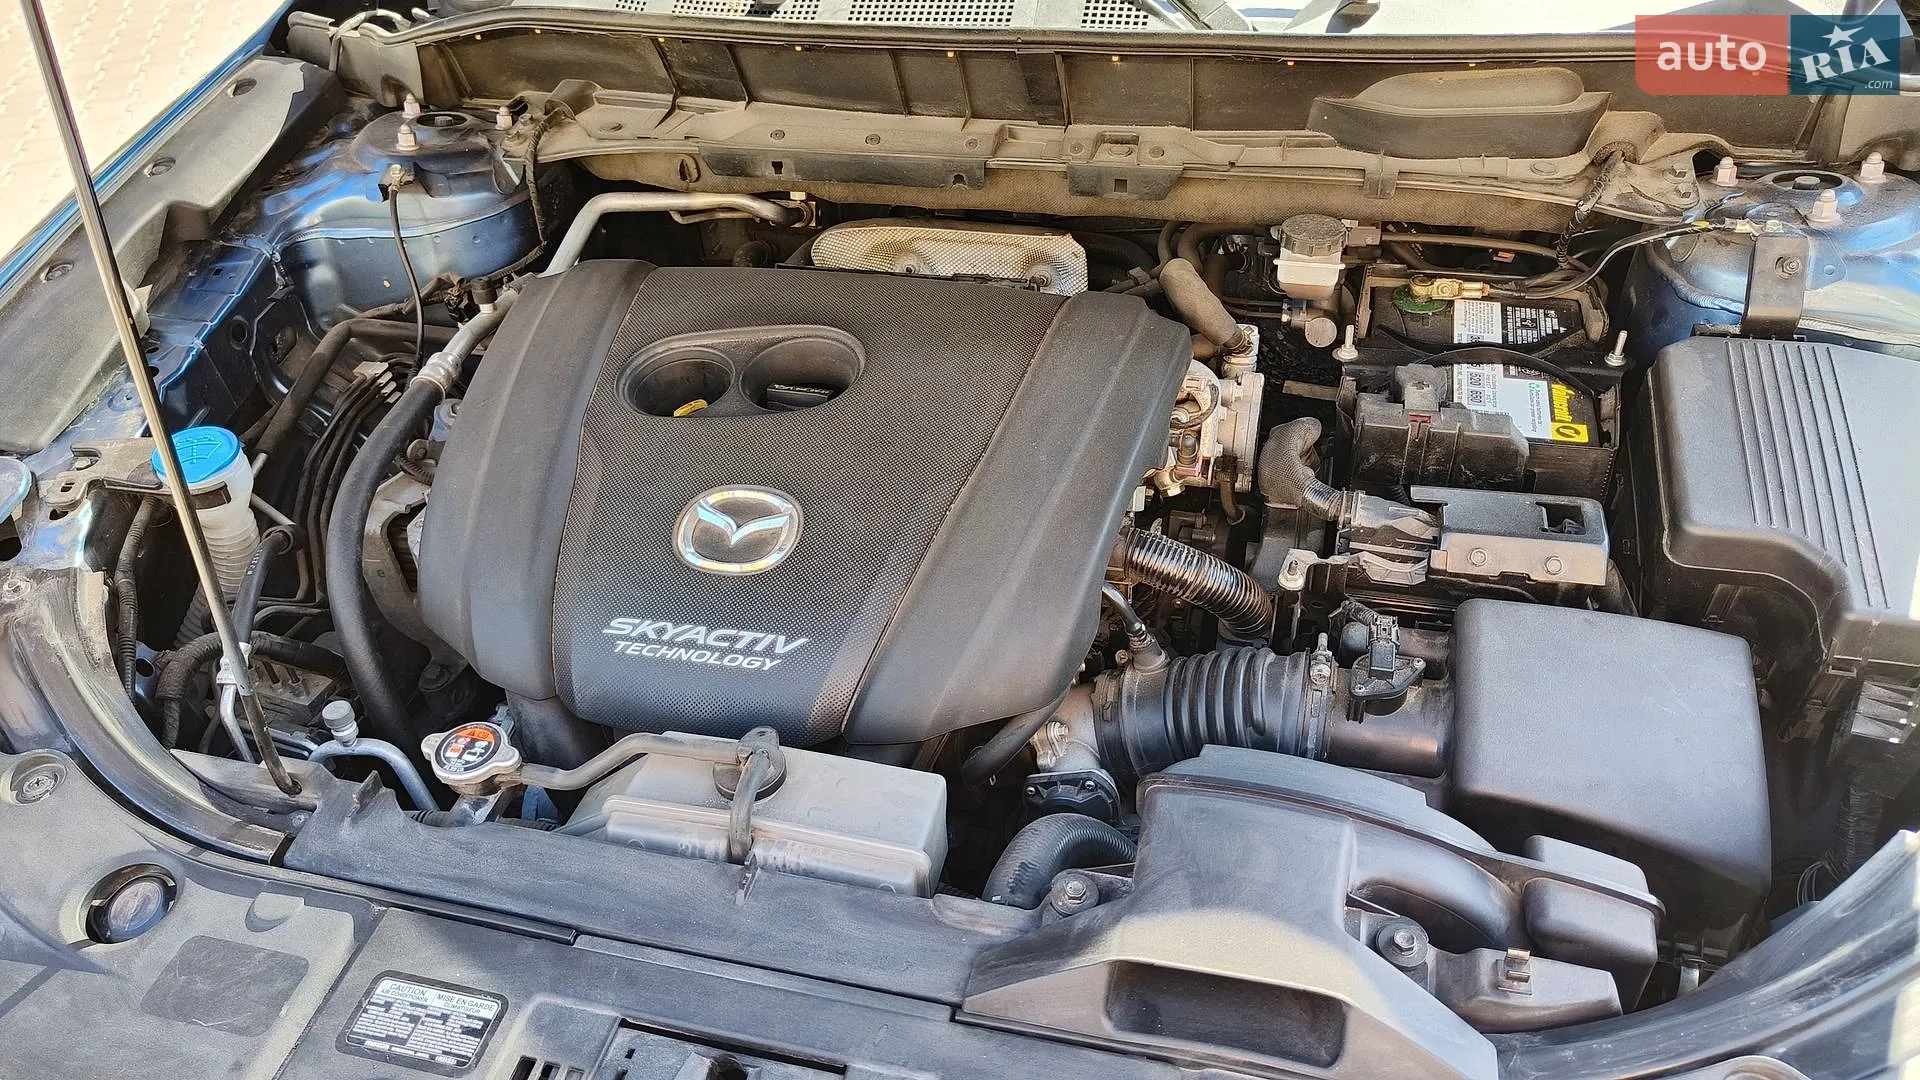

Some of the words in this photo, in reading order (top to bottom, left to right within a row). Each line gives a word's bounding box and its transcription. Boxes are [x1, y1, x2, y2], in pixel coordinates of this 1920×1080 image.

[1470, 372, 1482, 386] 520
[1470, 390, 1482, 404] 650
[603, 617, 809, 654] SKYACTIV
[613, 641, 782, 671] TECHNOLOGY
[389, 983, 428, 997] CAUTION
[390, 990, 429, 1003] CONDITIONER
[436, 993, 458, 1003] MISE
[457, 997, 467, 1005] EN
[467, 998, 495, 1012] GARDE
[443, 1002, 482, 1015] CLIMATISEUR
